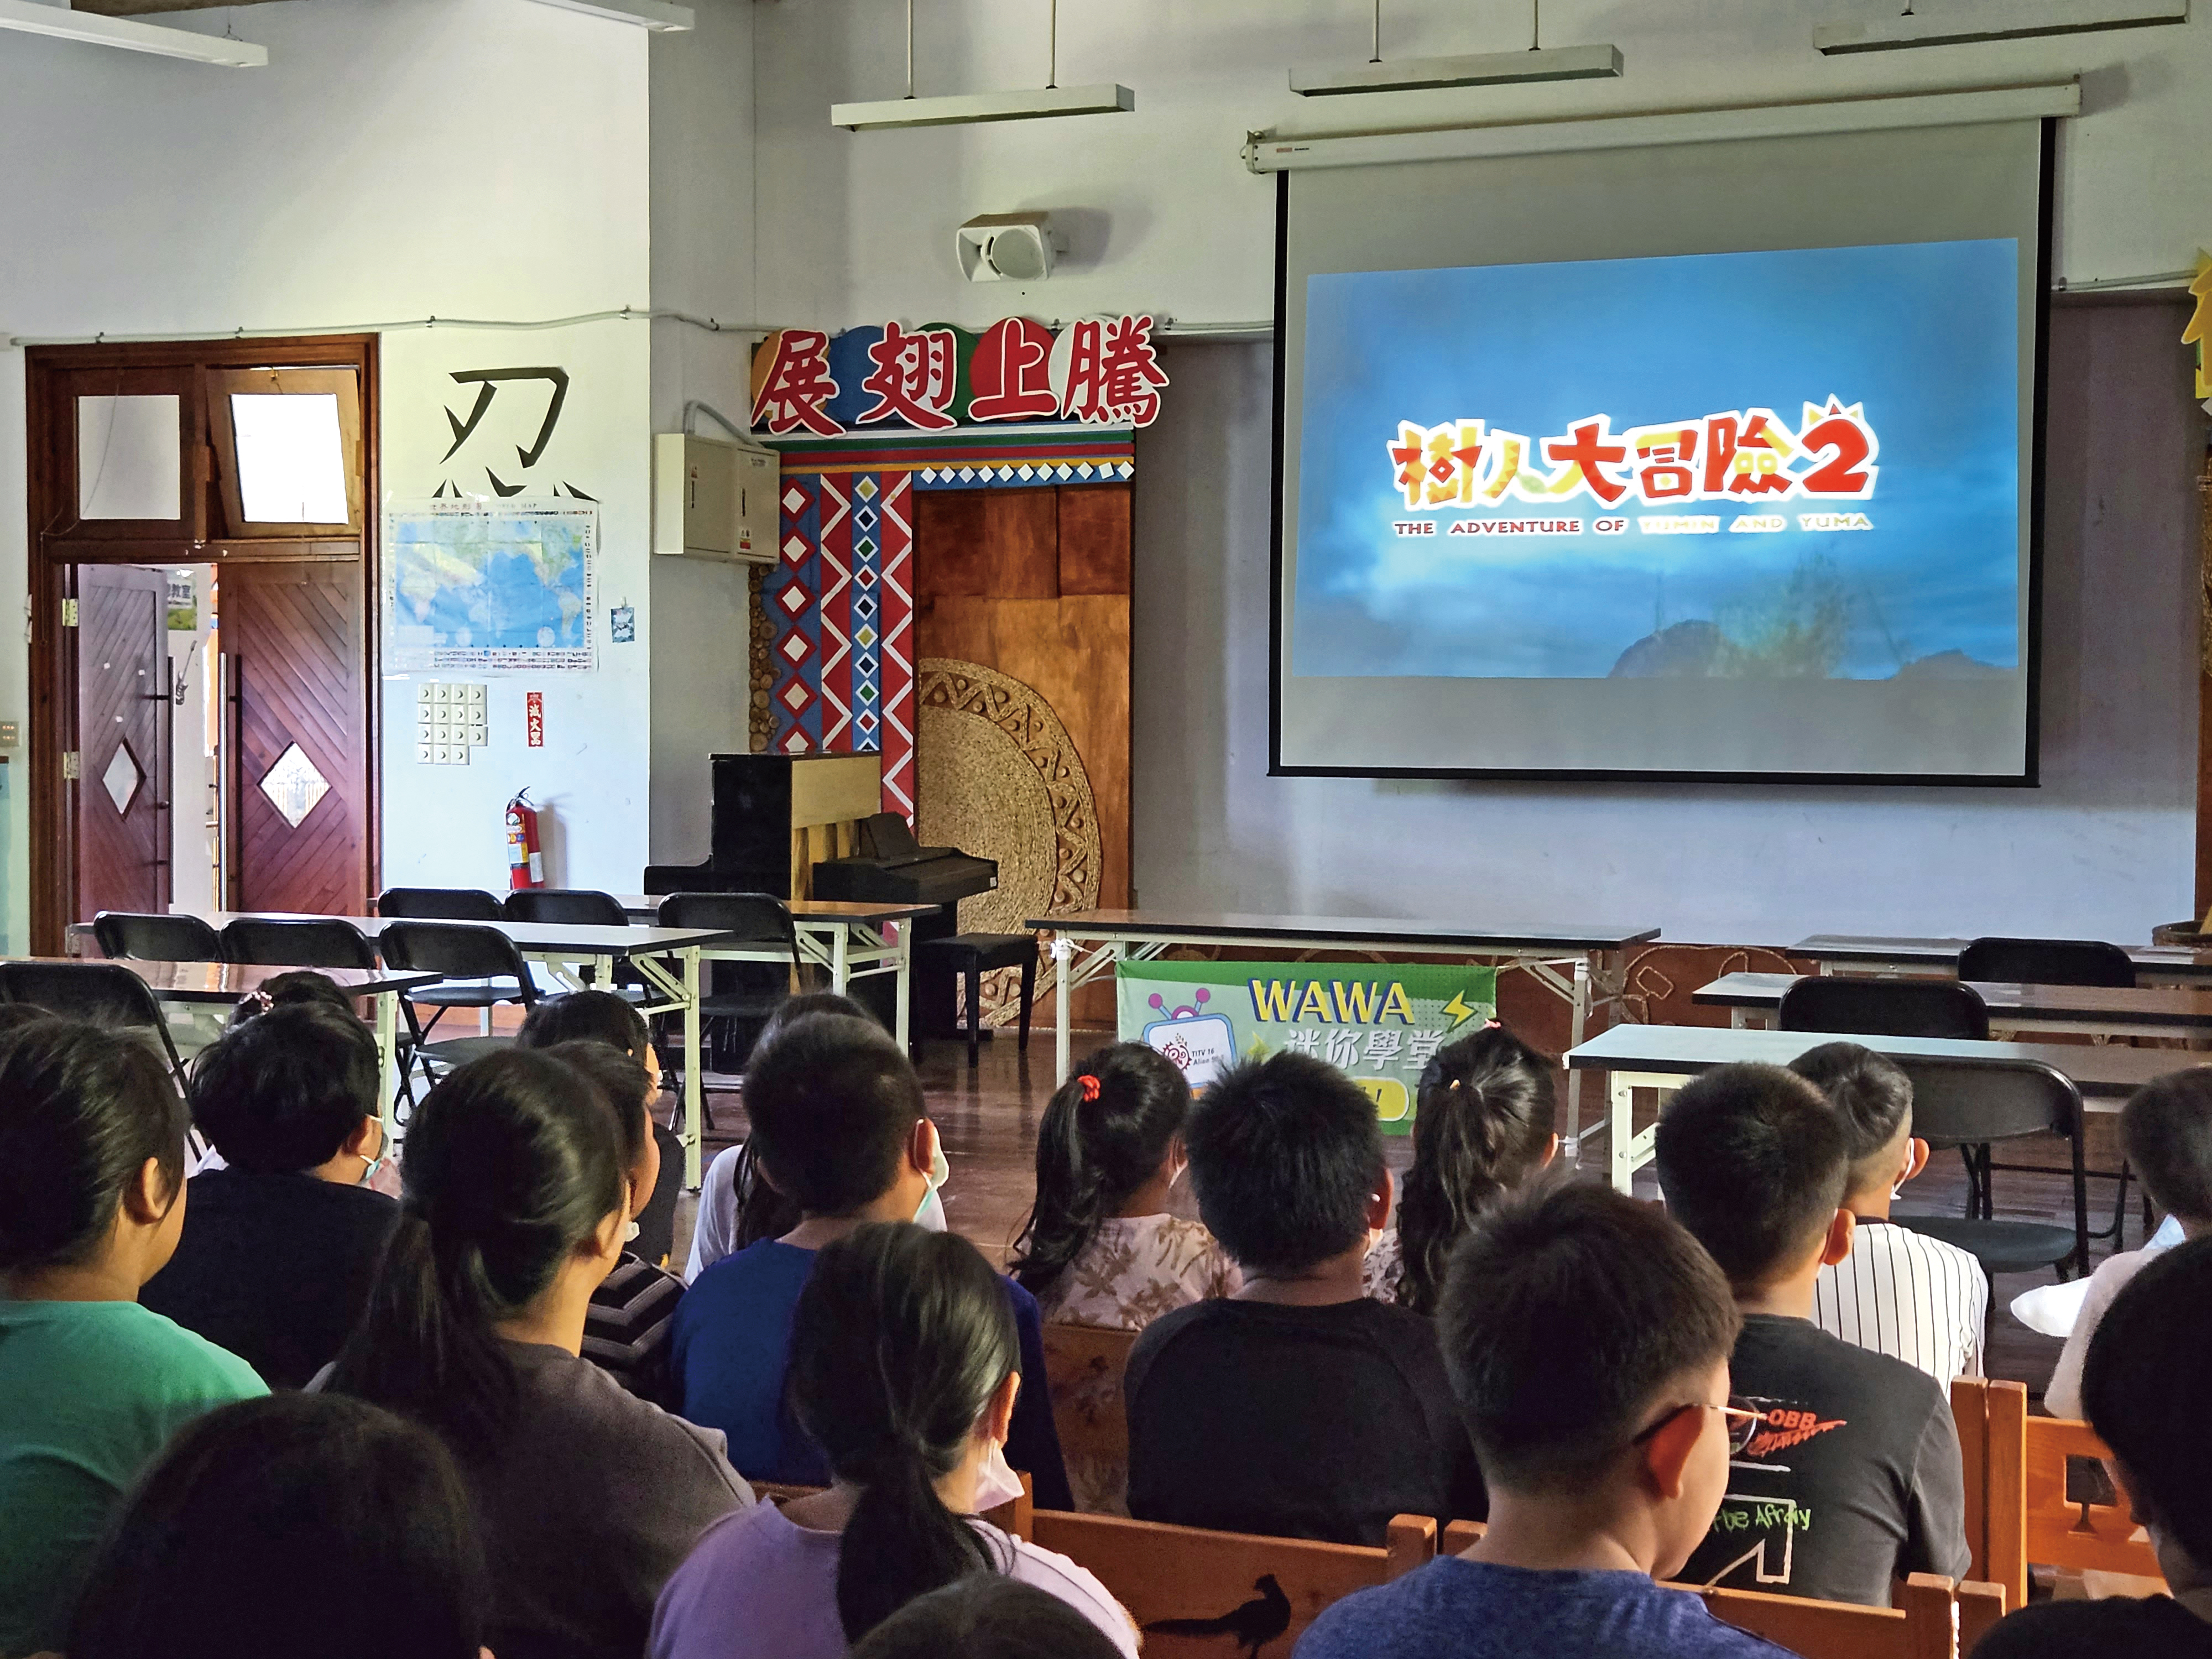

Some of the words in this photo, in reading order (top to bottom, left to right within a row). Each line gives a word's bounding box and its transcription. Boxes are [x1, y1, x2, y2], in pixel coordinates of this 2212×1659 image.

[750, 315, 1170, 437] 展翅上騰
[1394, 523, 1434, 534] THE
[1451, 520, 1580, 534] ADVENTURE
[1595, 520, 1624, 531] OF
[1736, 518, 1783, 529] AND
[1802, 517, 1869, 527] YUMA
[1247, 978, 1416, 1025] WAWA
[1192, 1049, 1206, 1057] TITV
